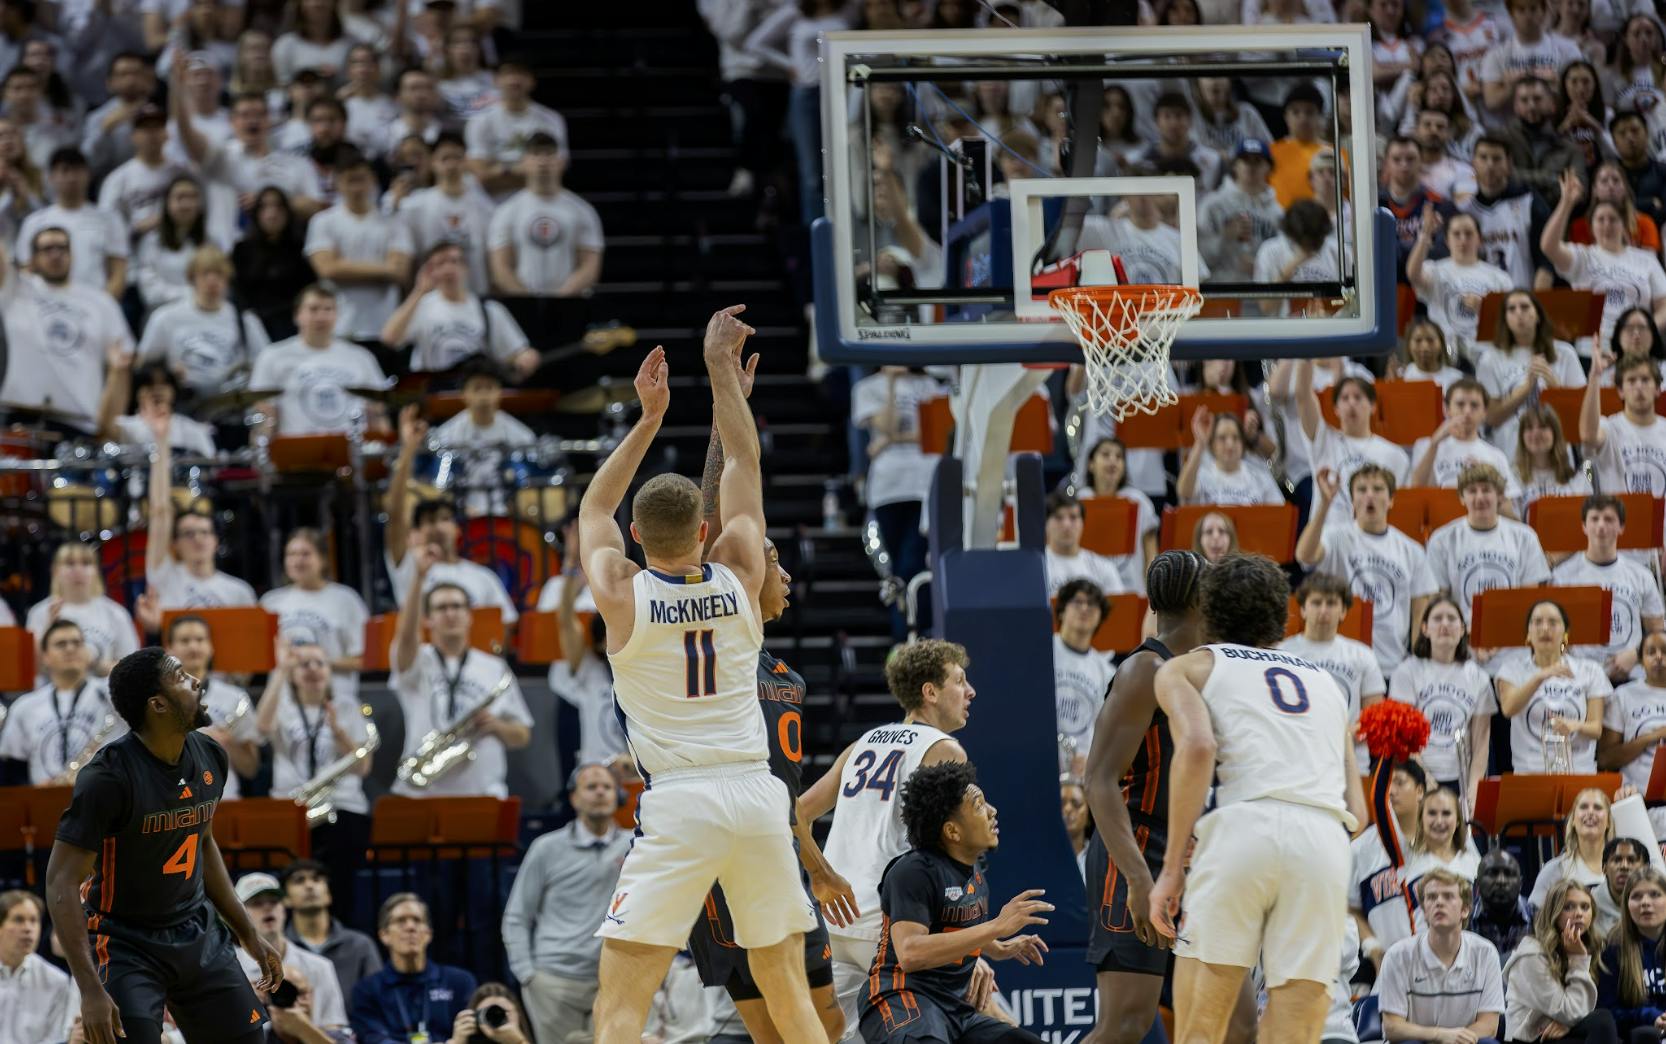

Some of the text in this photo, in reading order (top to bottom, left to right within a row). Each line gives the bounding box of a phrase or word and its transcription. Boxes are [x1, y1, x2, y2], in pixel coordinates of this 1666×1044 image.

[650, 591, 738, 624] McKNEELY
[684, 629, 717, 698] 11
[1220, 647, 1320, 672] BUCHANAN
[1264, 666, 1310, 713] 0
[777, 710, 803, 763] 0
[867, 729, 919, 745] GROVES
[842, 749, 906, 801] 34
[163, 833, 199, 881] 4
[991, 987, 1100, 1026] NITE
